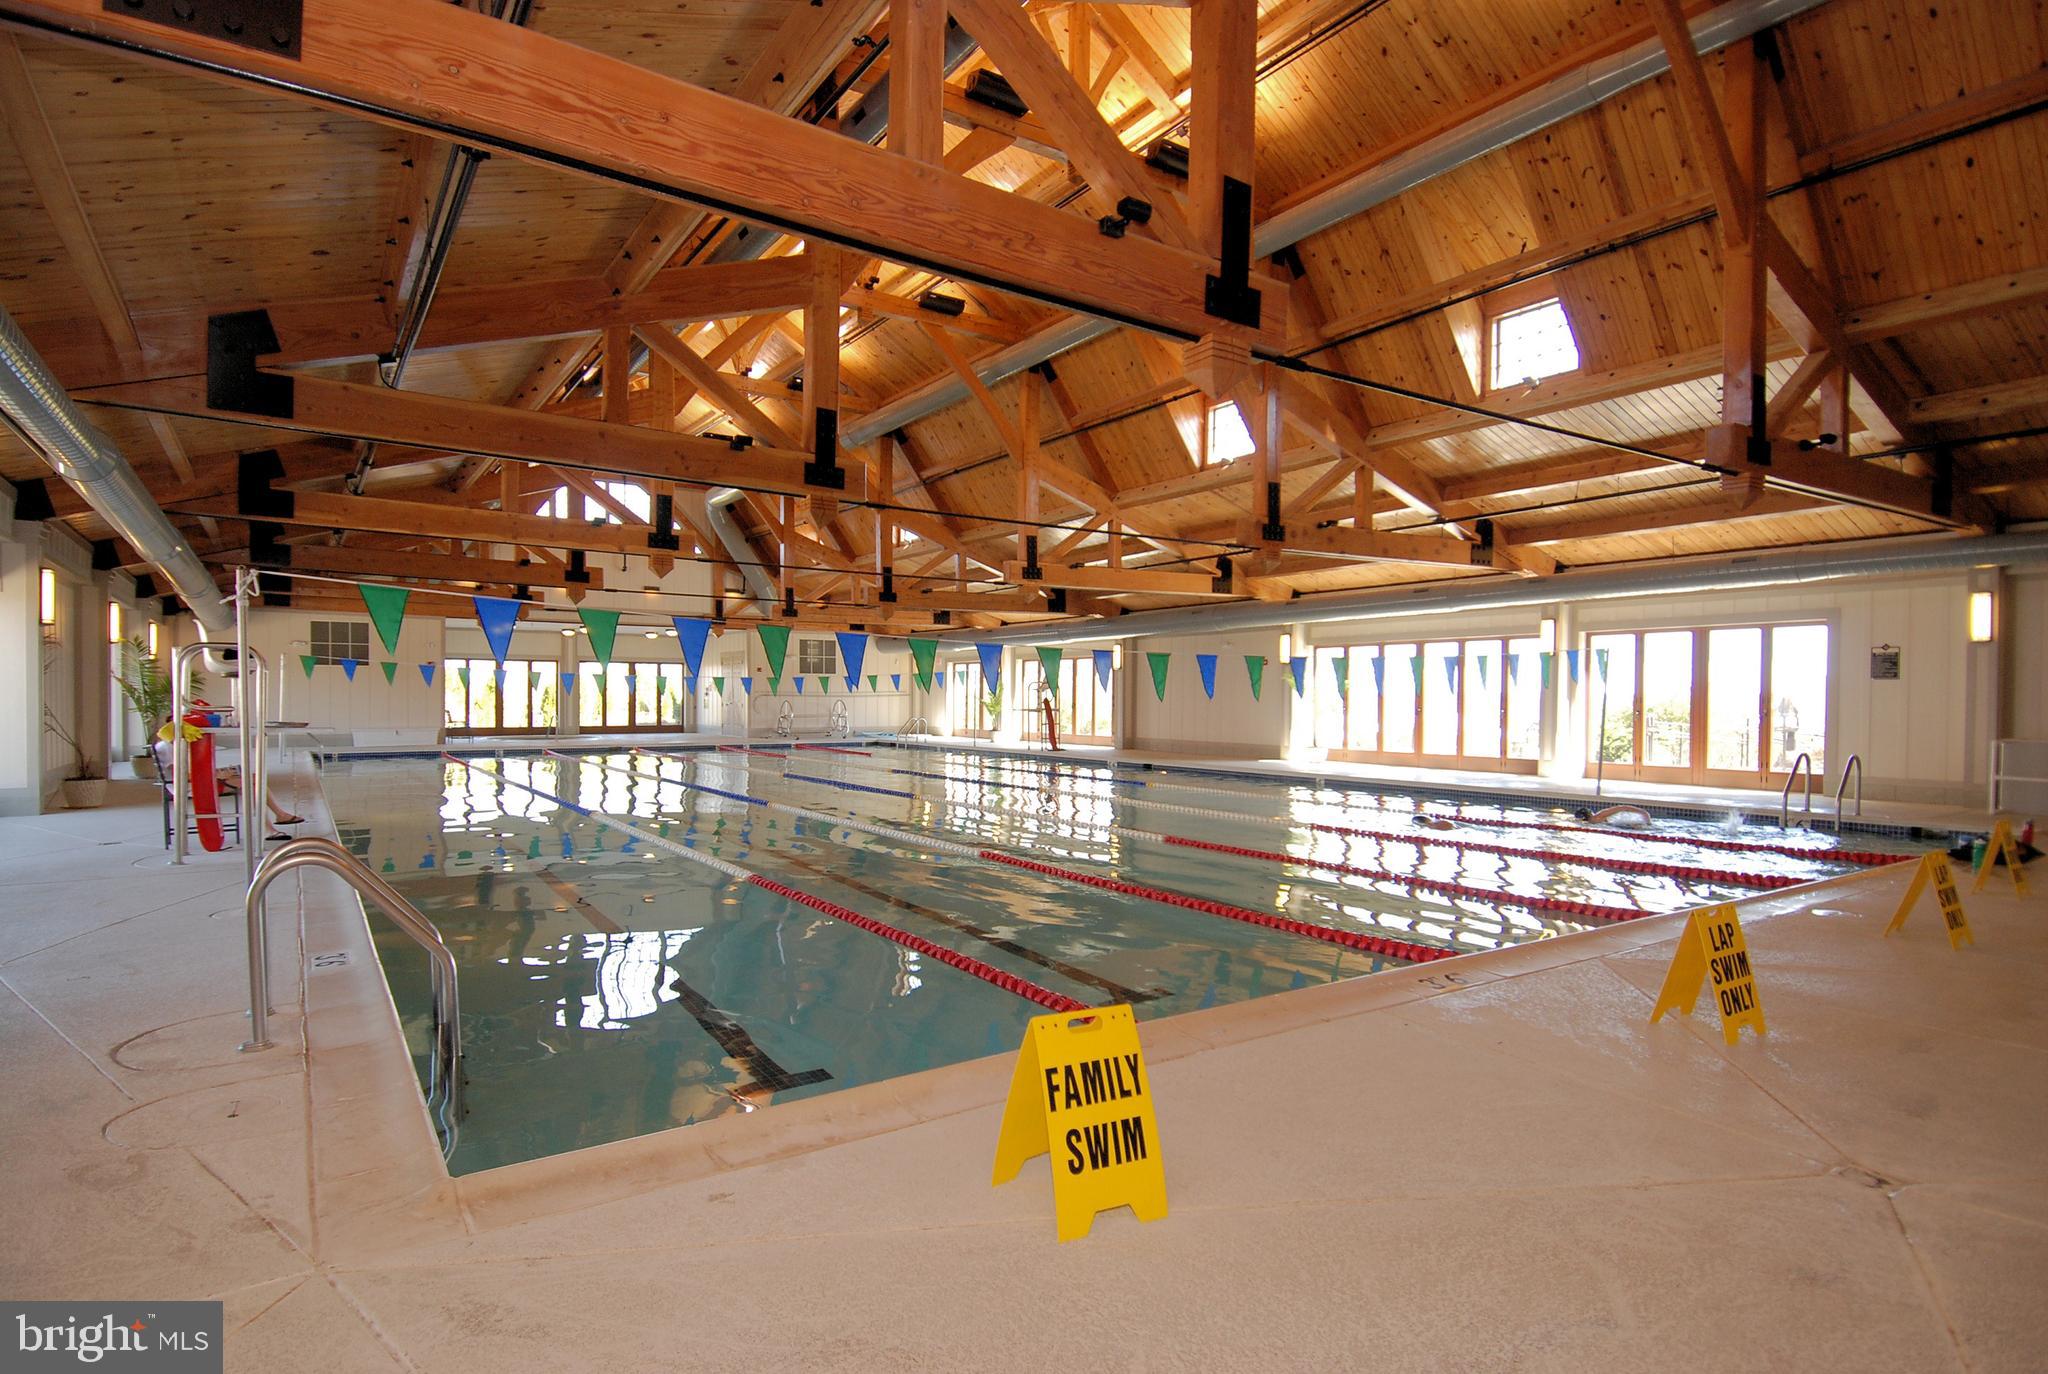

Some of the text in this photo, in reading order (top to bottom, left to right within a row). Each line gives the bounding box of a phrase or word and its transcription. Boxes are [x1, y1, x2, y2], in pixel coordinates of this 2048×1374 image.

[1709, 923, 1734, 952] LAP
[1711, 951, 1751, 985] SWIM
[1720, 982, 1755, 1017] ONLY
[1045, 1053, 1142, 1112] FAMILY
[1065, 1116, 1147, 1175] SWIM
